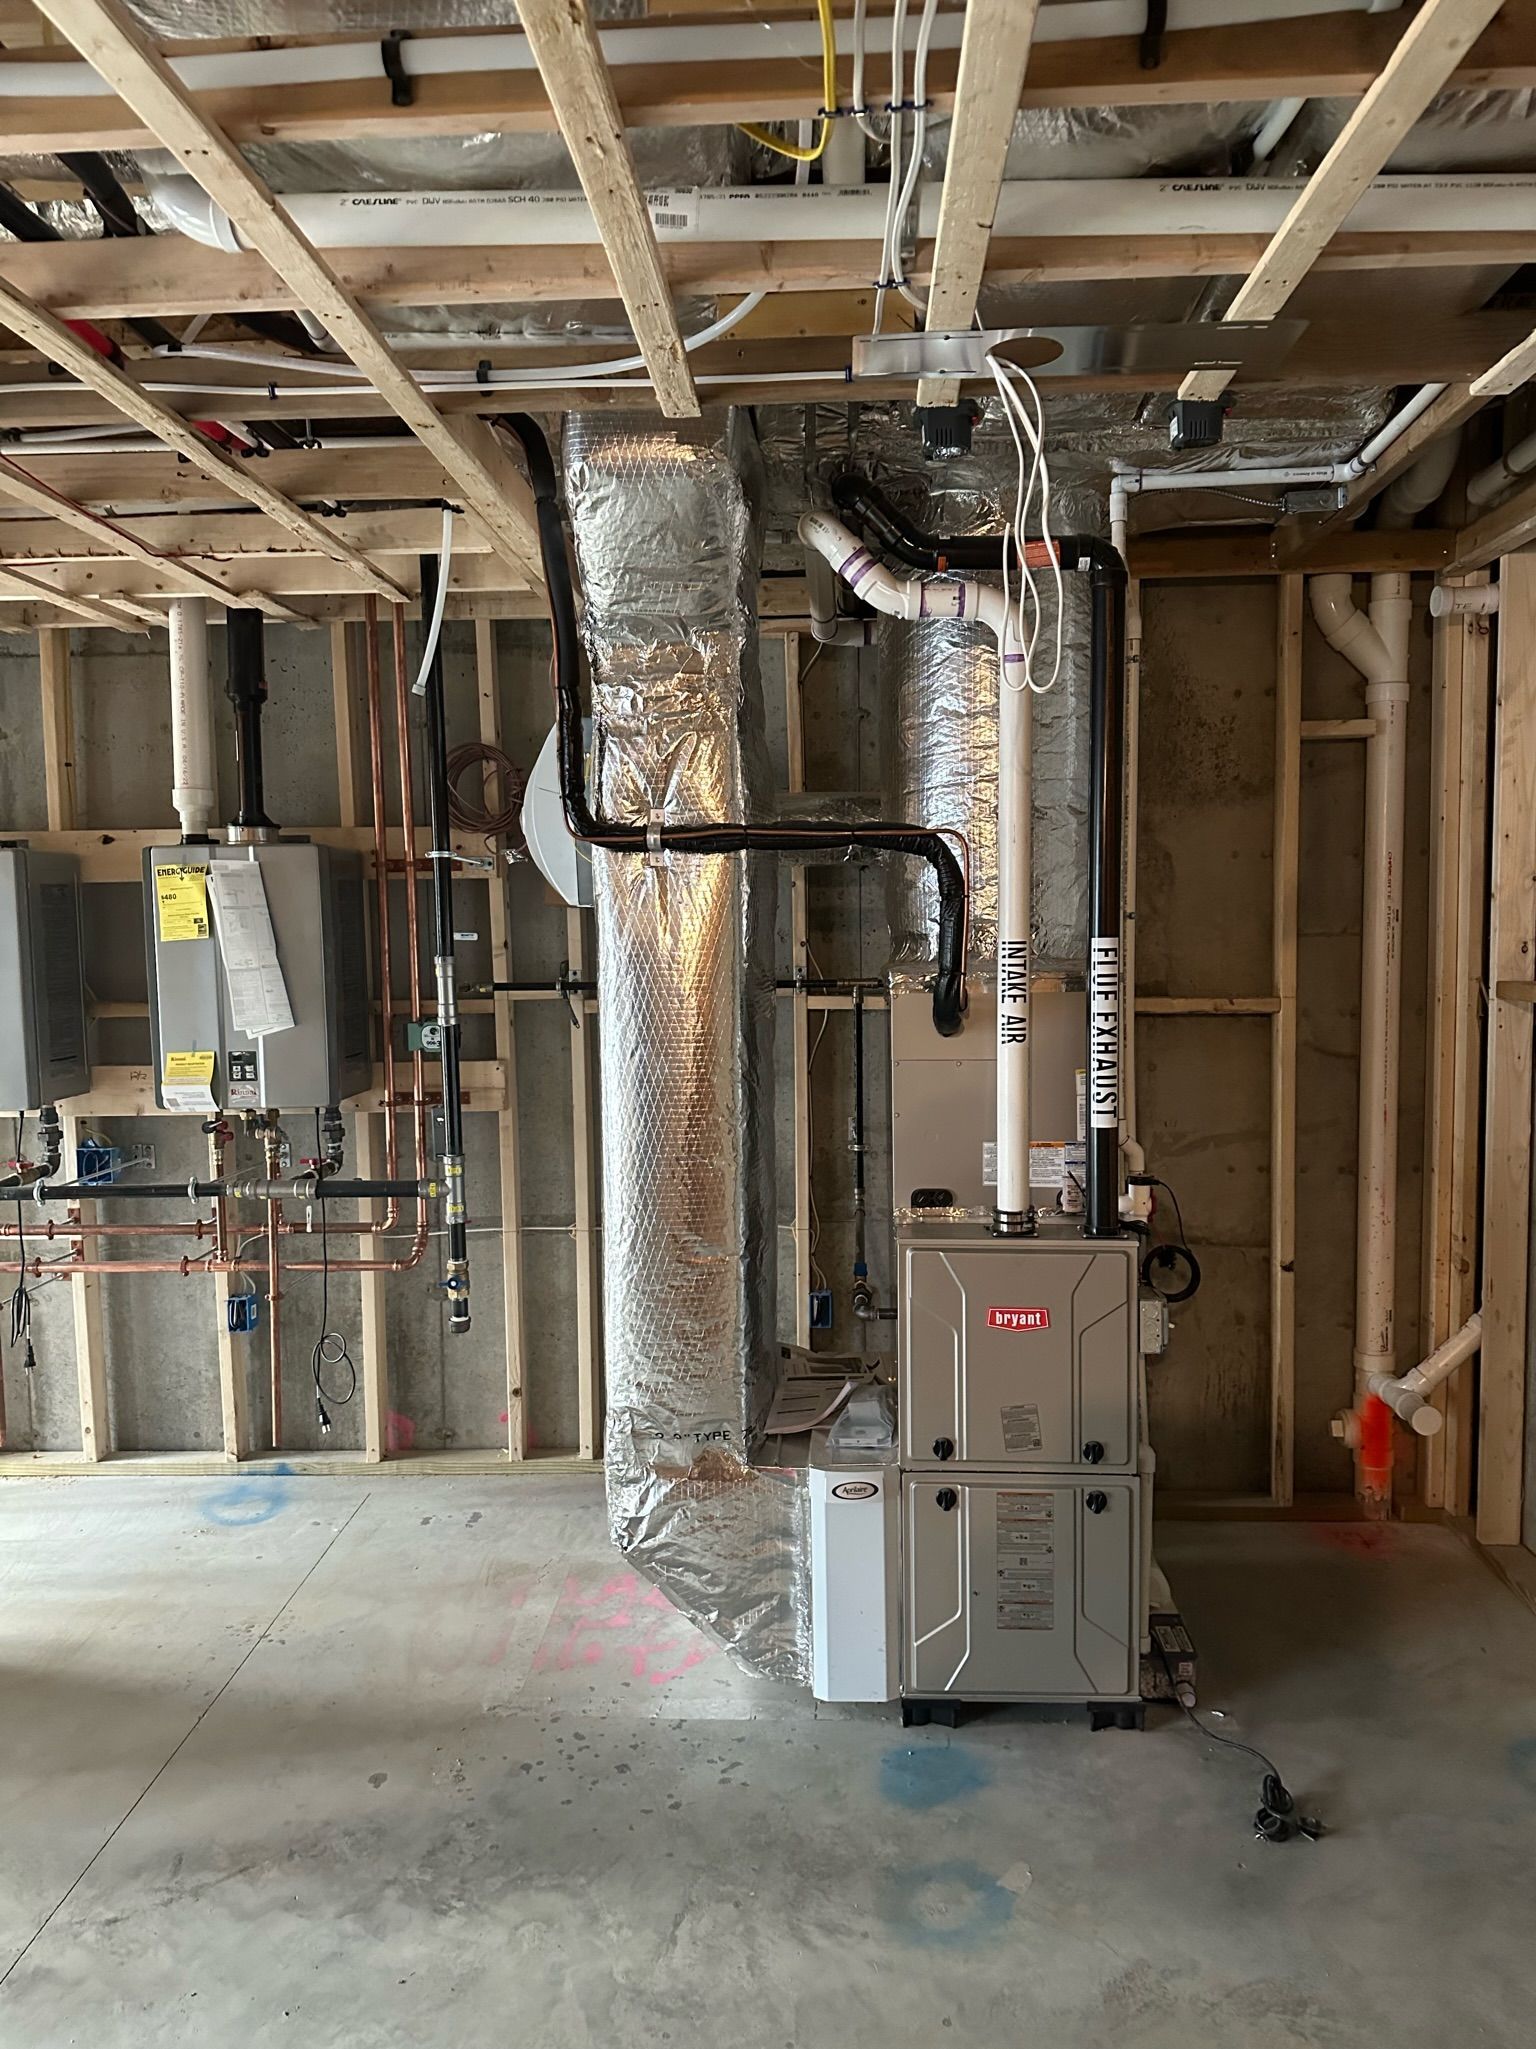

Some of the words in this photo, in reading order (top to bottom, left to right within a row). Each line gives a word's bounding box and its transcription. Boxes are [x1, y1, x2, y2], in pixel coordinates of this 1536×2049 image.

[508, 195, 526, 204] SCH
[528, 195, 540, 203] 40
[1001, 940, 1027, 1004] INTAKE
[1092, 947, 1117, 1001] FLUE
[1001, 1013, 1027, 1044] AIR
[1092, 1011, 1118, 1118] EXHAUST
[230, 1088, 257, 1096] Rinnai
[995, 1311, 1041, 1327] bryant
[693, 1430, 731, 1443] TYPE
